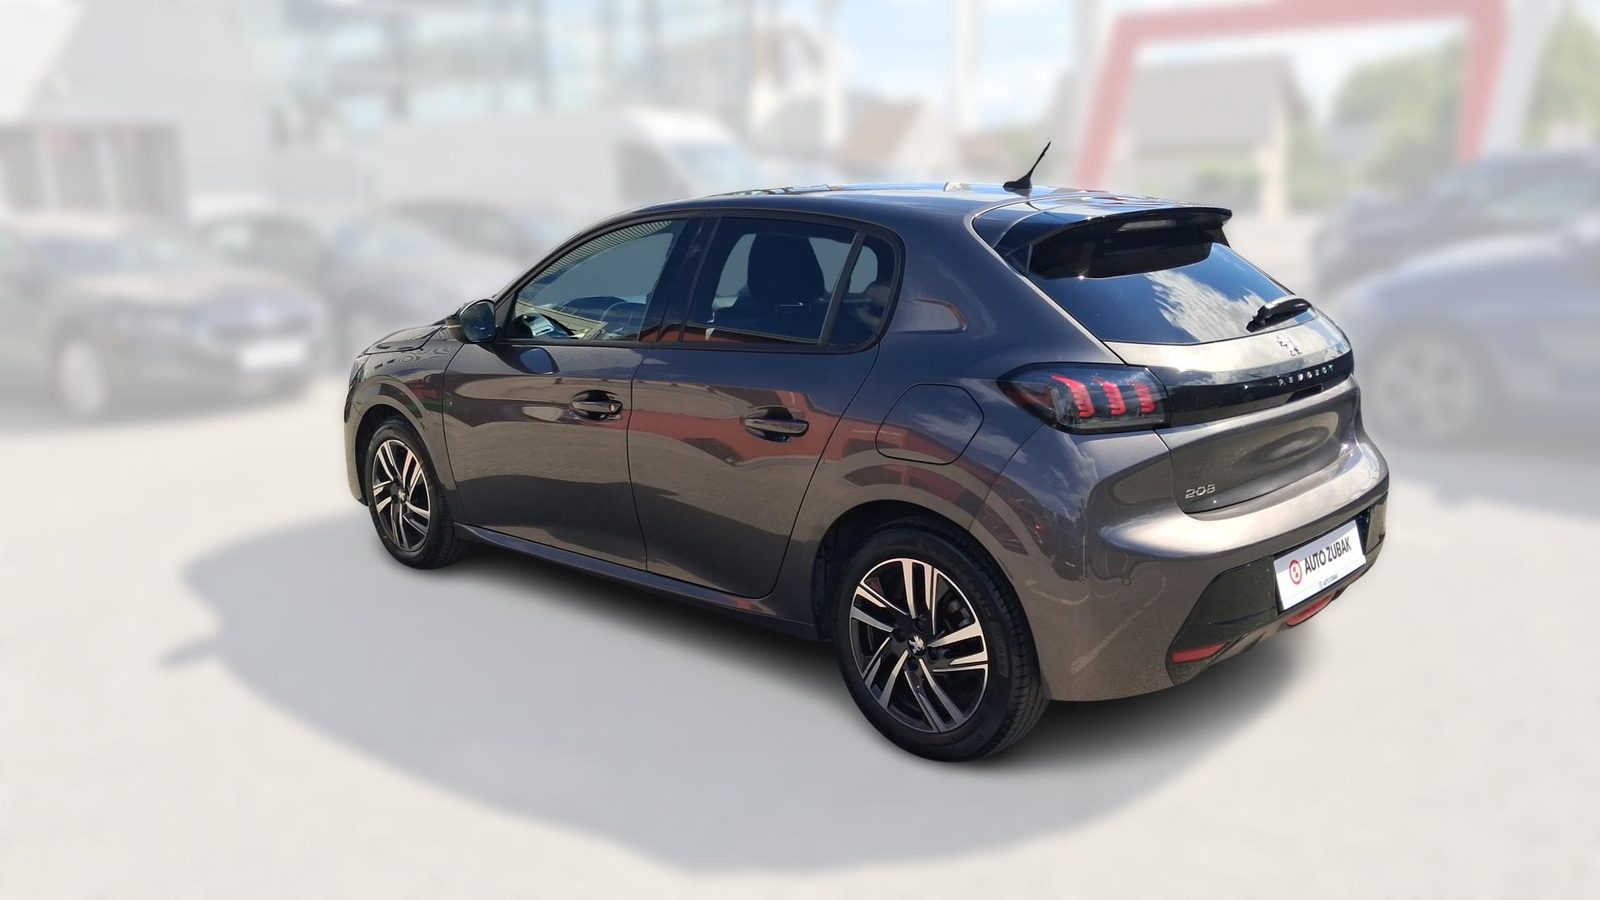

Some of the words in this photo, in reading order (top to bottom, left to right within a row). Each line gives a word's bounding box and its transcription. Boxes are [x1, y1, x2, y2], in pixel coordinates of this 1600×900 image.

[1278, 364, 1334, 387] PEUGEOT
[1184, 484, 1216, 499] 208
[1304, 551, 1326, 575] AUTO
[1326, 536, 1352, 562] ZUBAK
